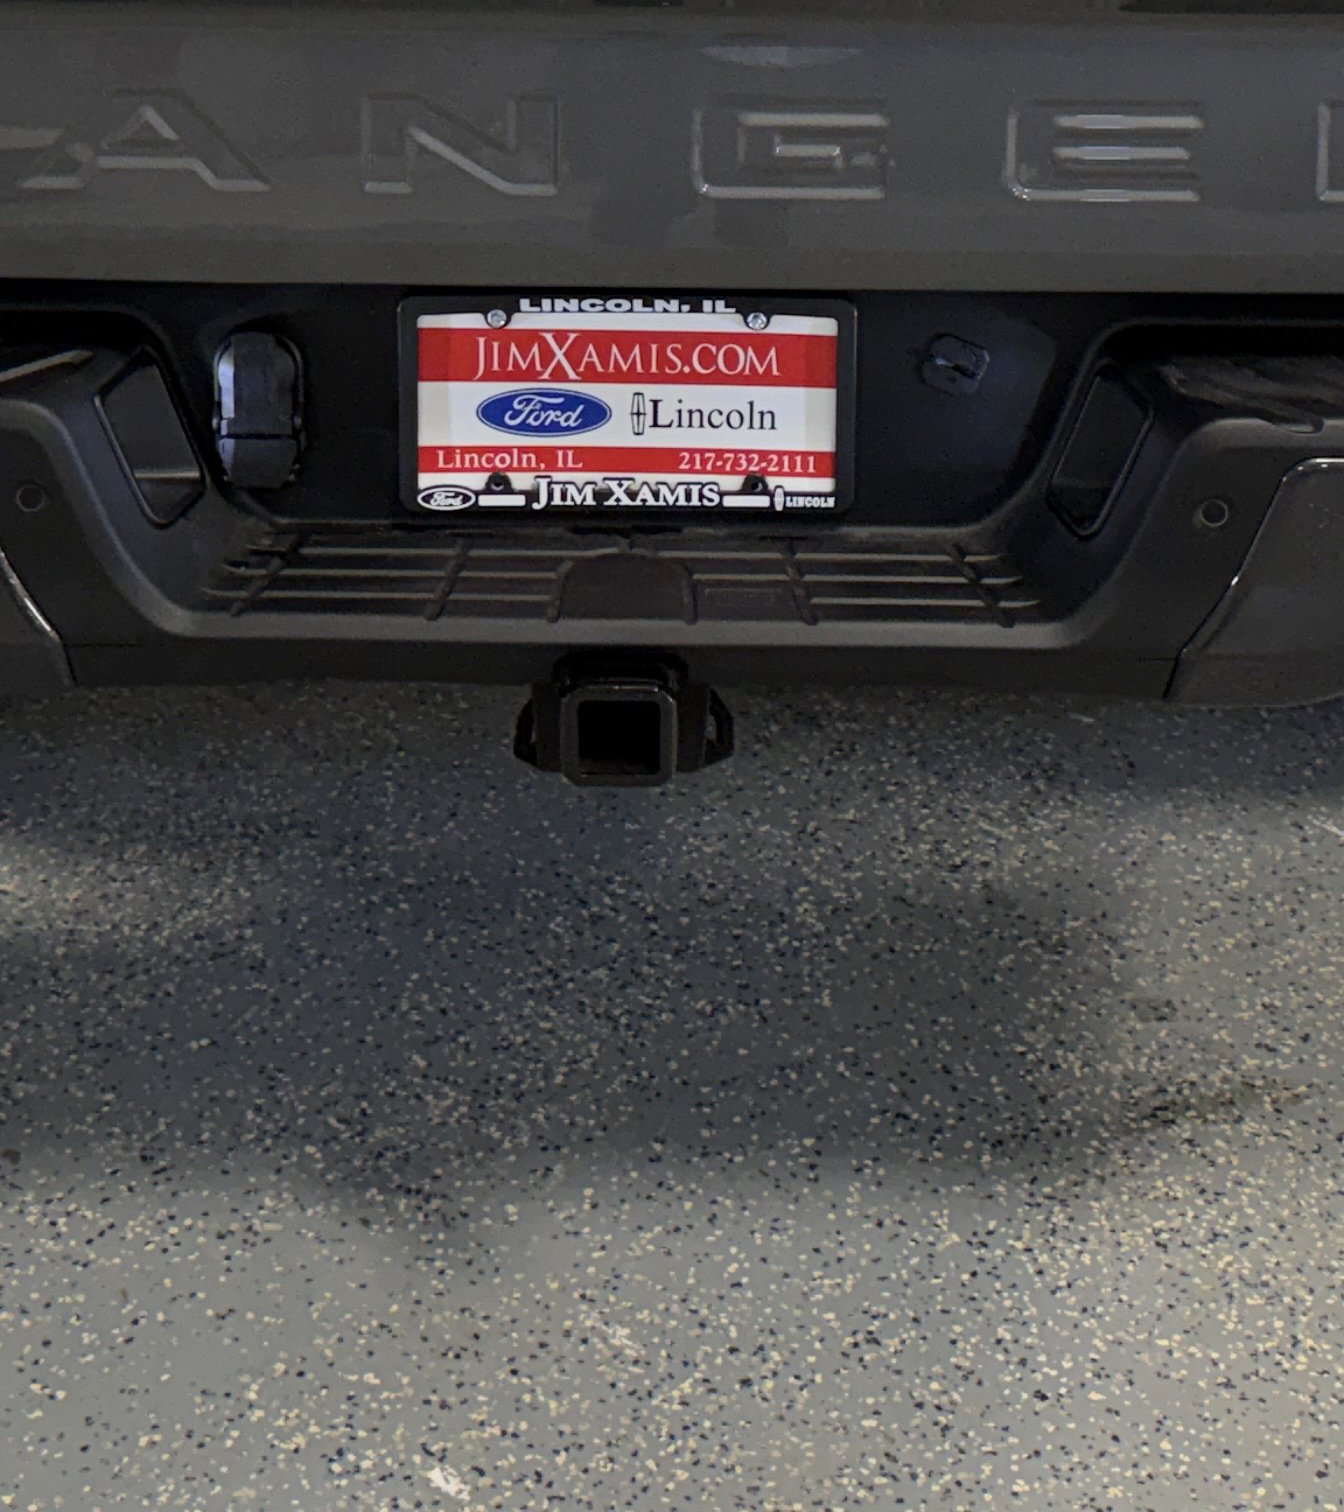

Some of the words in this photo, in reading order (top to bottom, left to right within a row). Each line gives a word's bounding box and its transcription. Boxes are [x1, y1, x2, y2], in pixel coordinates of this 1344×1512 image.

[519, 297, 692, 315] LINCOLN,
[702, 299, 737, 313] IL
[472, 331, 782, 381] JIMXAMIS.COM
[503, 394, 586, 428] Ford
[648, 398, 778, 432] Lincoln
[436, 449, 547, 471] Lincoln,
[555, 450, 584, 469] IL
[678, 451, 817, 474] 217-732-2111
[430, 491, 464, 507] Ford
[531, 476, 598, 511] JIM
[602, 478, 722, 507] XAMIS
